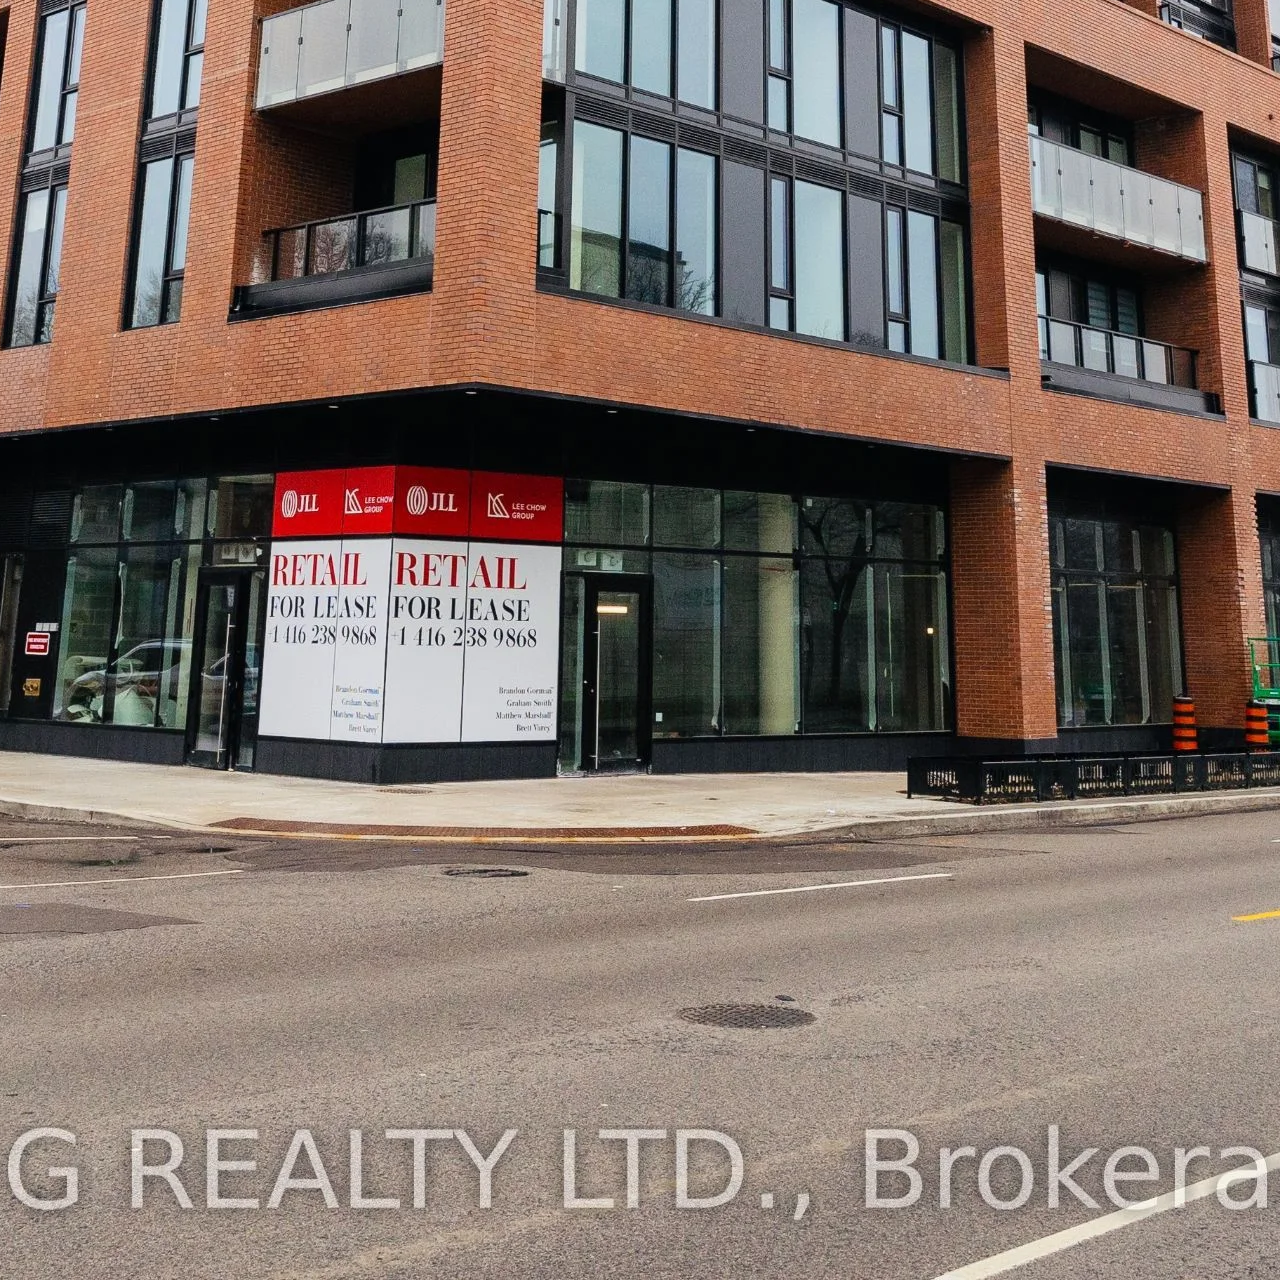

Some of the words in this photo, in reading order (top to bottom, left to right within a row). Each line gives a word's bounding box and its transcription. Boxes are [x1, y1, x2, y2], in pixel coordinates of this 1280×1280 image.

[297, 494, 319, 513] JLL
[364, 496, 376, 504] LEE
[376, 495, 393, 504] CHOW
[364, 505, 384, 513] GROUP
[428, 492, 458, 512] JLL
[511, 512, 535, 520] GROUP
[271, 552, 368, 586] RETAIL
[394, 552, 527, 590] RETAIL
[269, 595, 305, 618] FOR
[313, 595, 377, 618] LEASE
[392, 596, 441, 620] FOR
[450, 597, 530, 622] LEASE
[283, 625, 306, 644] 416
[311, 625, 337, 645] 238
[342, 625, 377, 646] 9868
[413, 626, 446, 646] 416
[452, 627, 487, 647] 238
[493, 627, 537, 648] 9868
[499, 686, 526, 694] Brandon
[495, 711, 522, 719] Matthew
[516, 723, 531, 732] Brett
